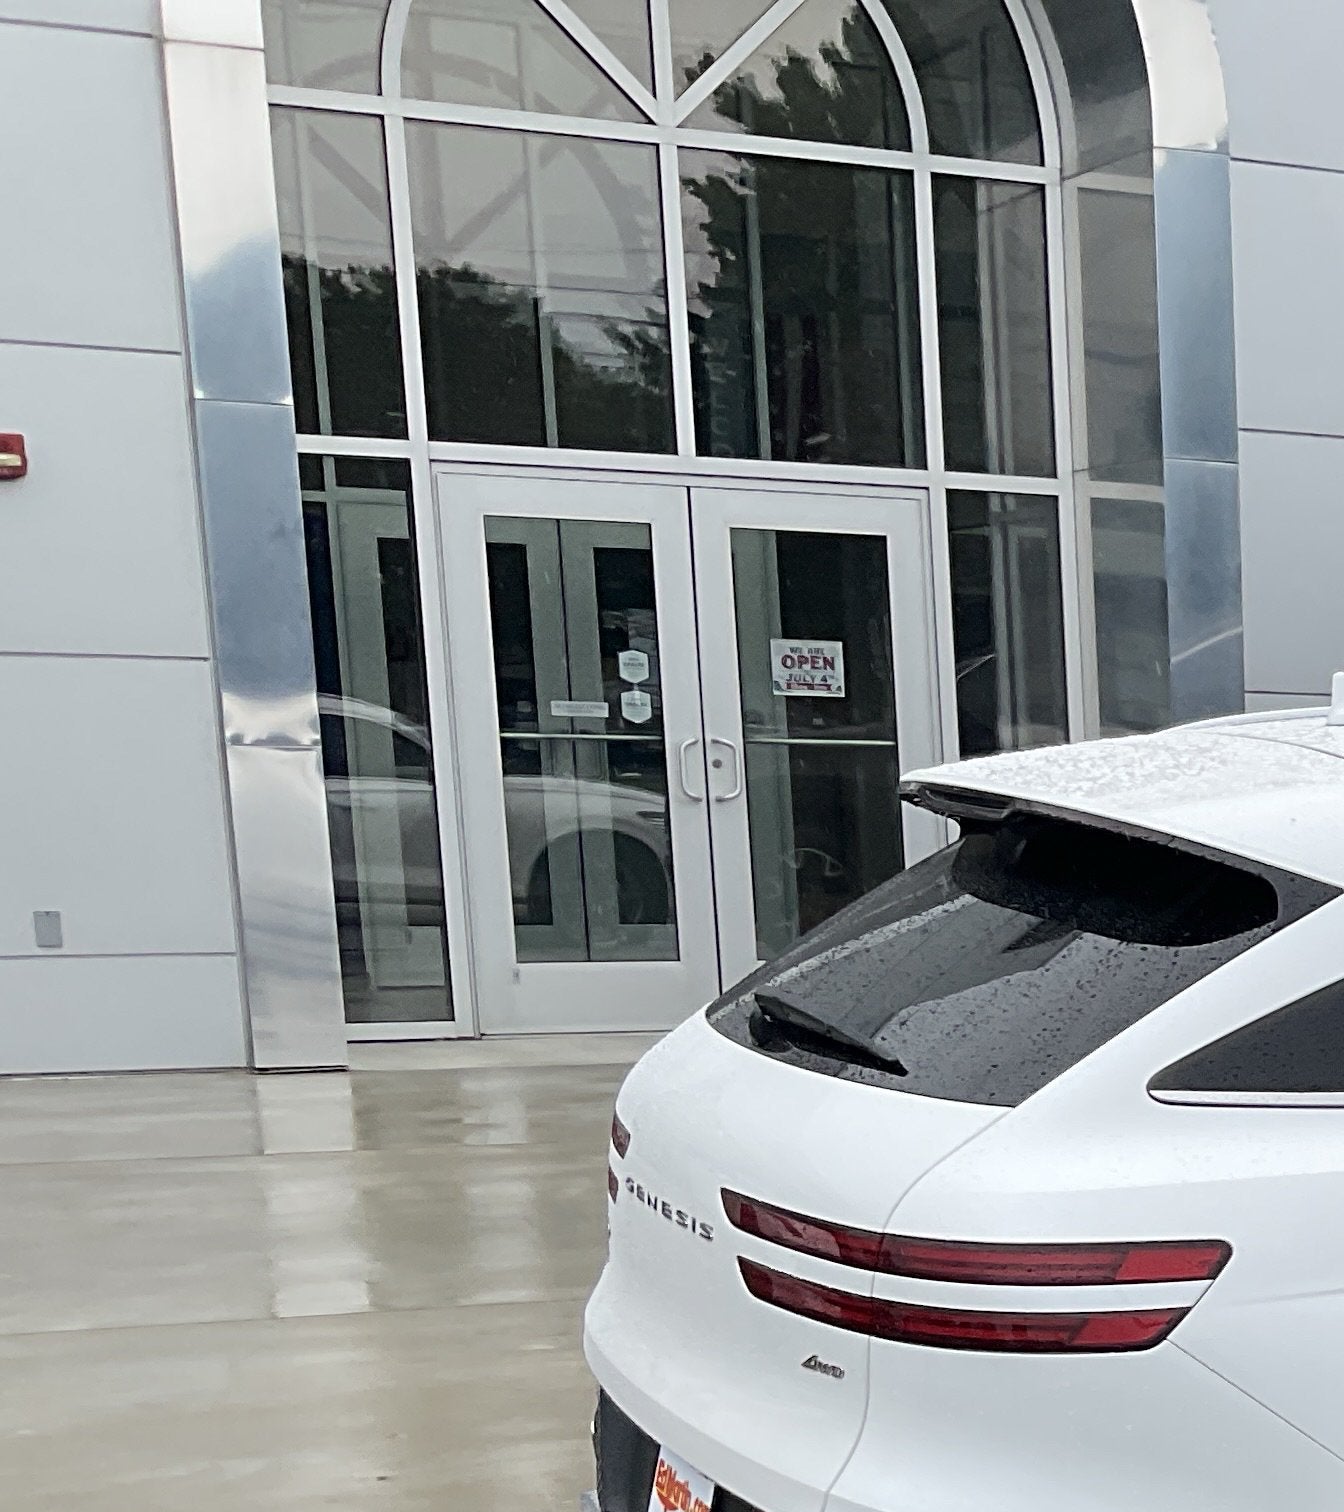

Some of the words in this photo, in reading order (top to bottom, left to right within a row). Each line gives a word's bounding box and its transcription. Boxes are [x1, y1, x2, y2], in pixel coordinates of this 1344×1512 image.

[781, 654, 836, 671] OPEN
[786, 673, 816, 684] JULY
[625, 1177, 714, 1241] GENESIS
